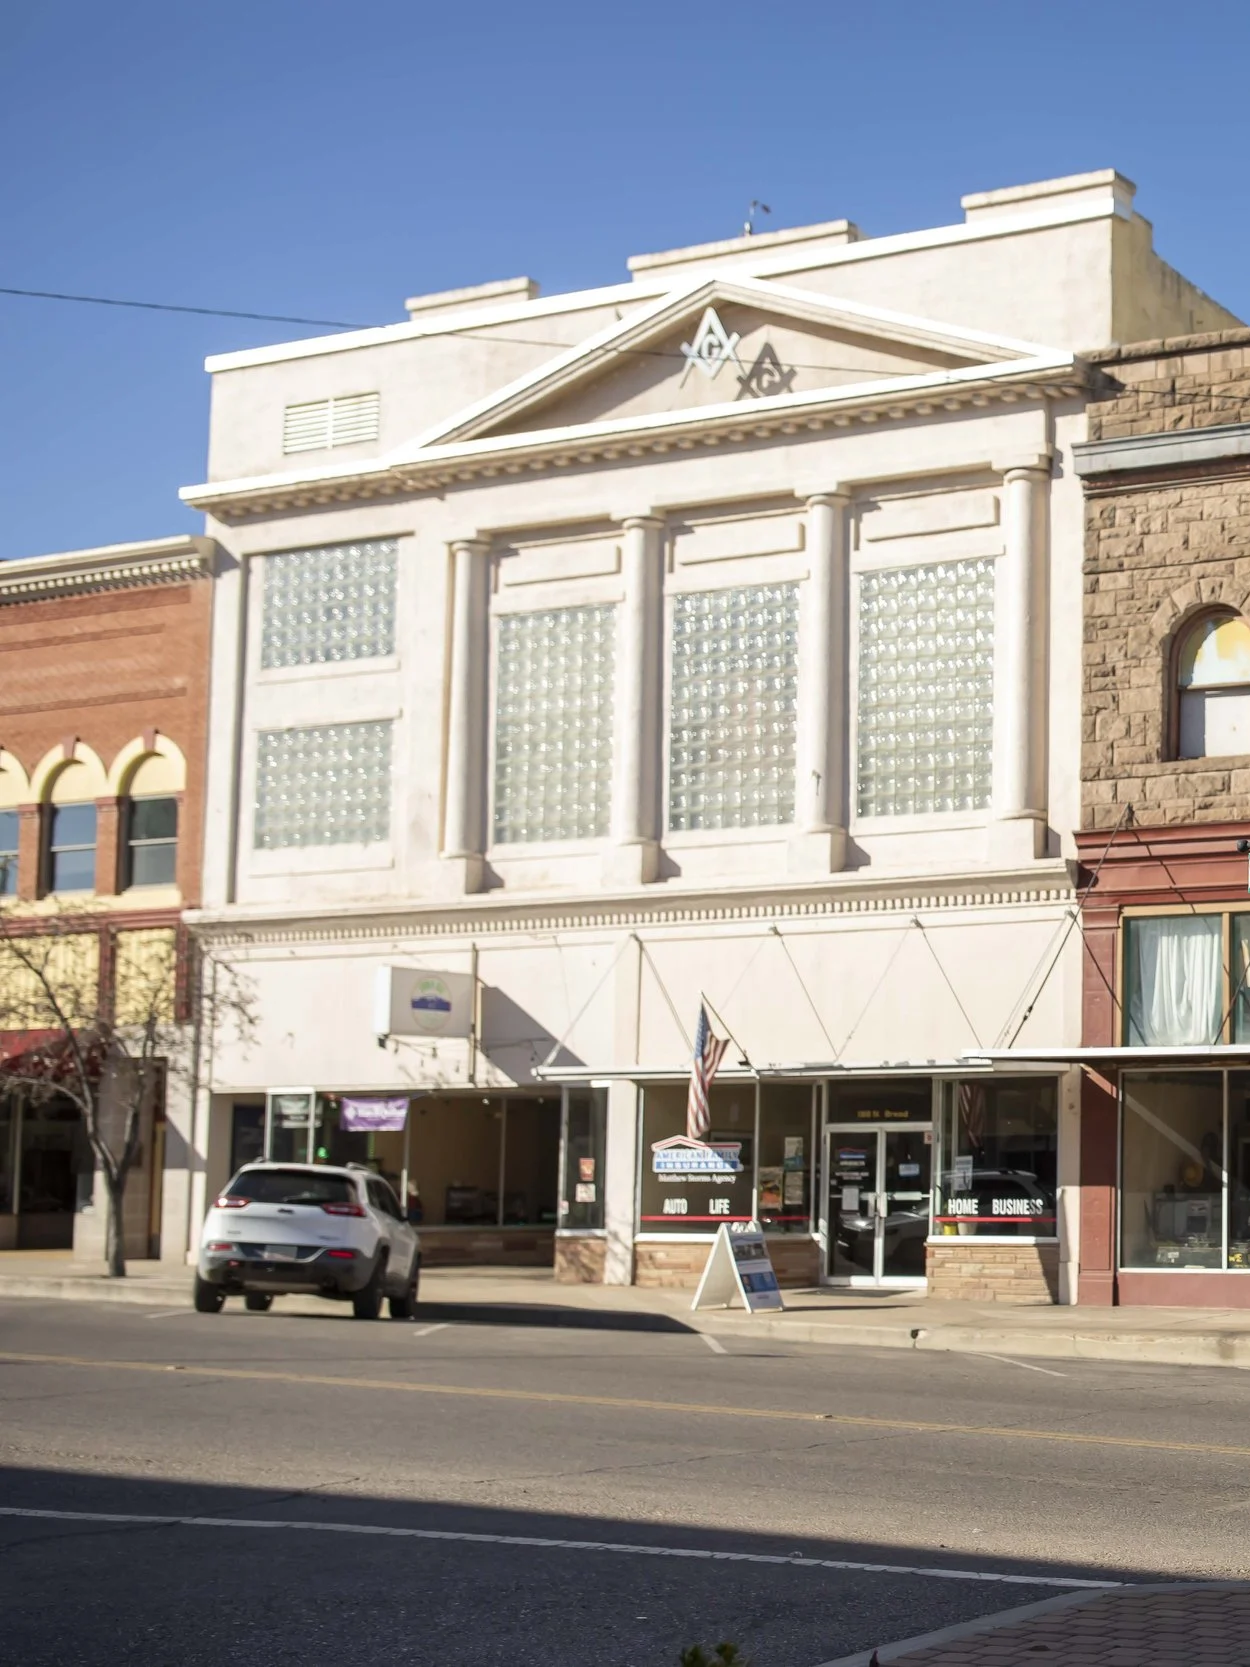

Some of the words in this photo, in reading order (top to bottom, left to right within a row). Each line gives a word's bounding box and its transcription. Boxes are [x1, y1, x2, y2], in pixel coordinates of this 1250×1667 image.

[656, 1151, 705, 1160] AMERICAN
[663, 1198, 688, 1214] AUTO
[709, 1198, 731, 1214] LIFE
[947, 1198, 979, 1215] HOME
[992, 1198, 1044, 1215] BUSINESS
